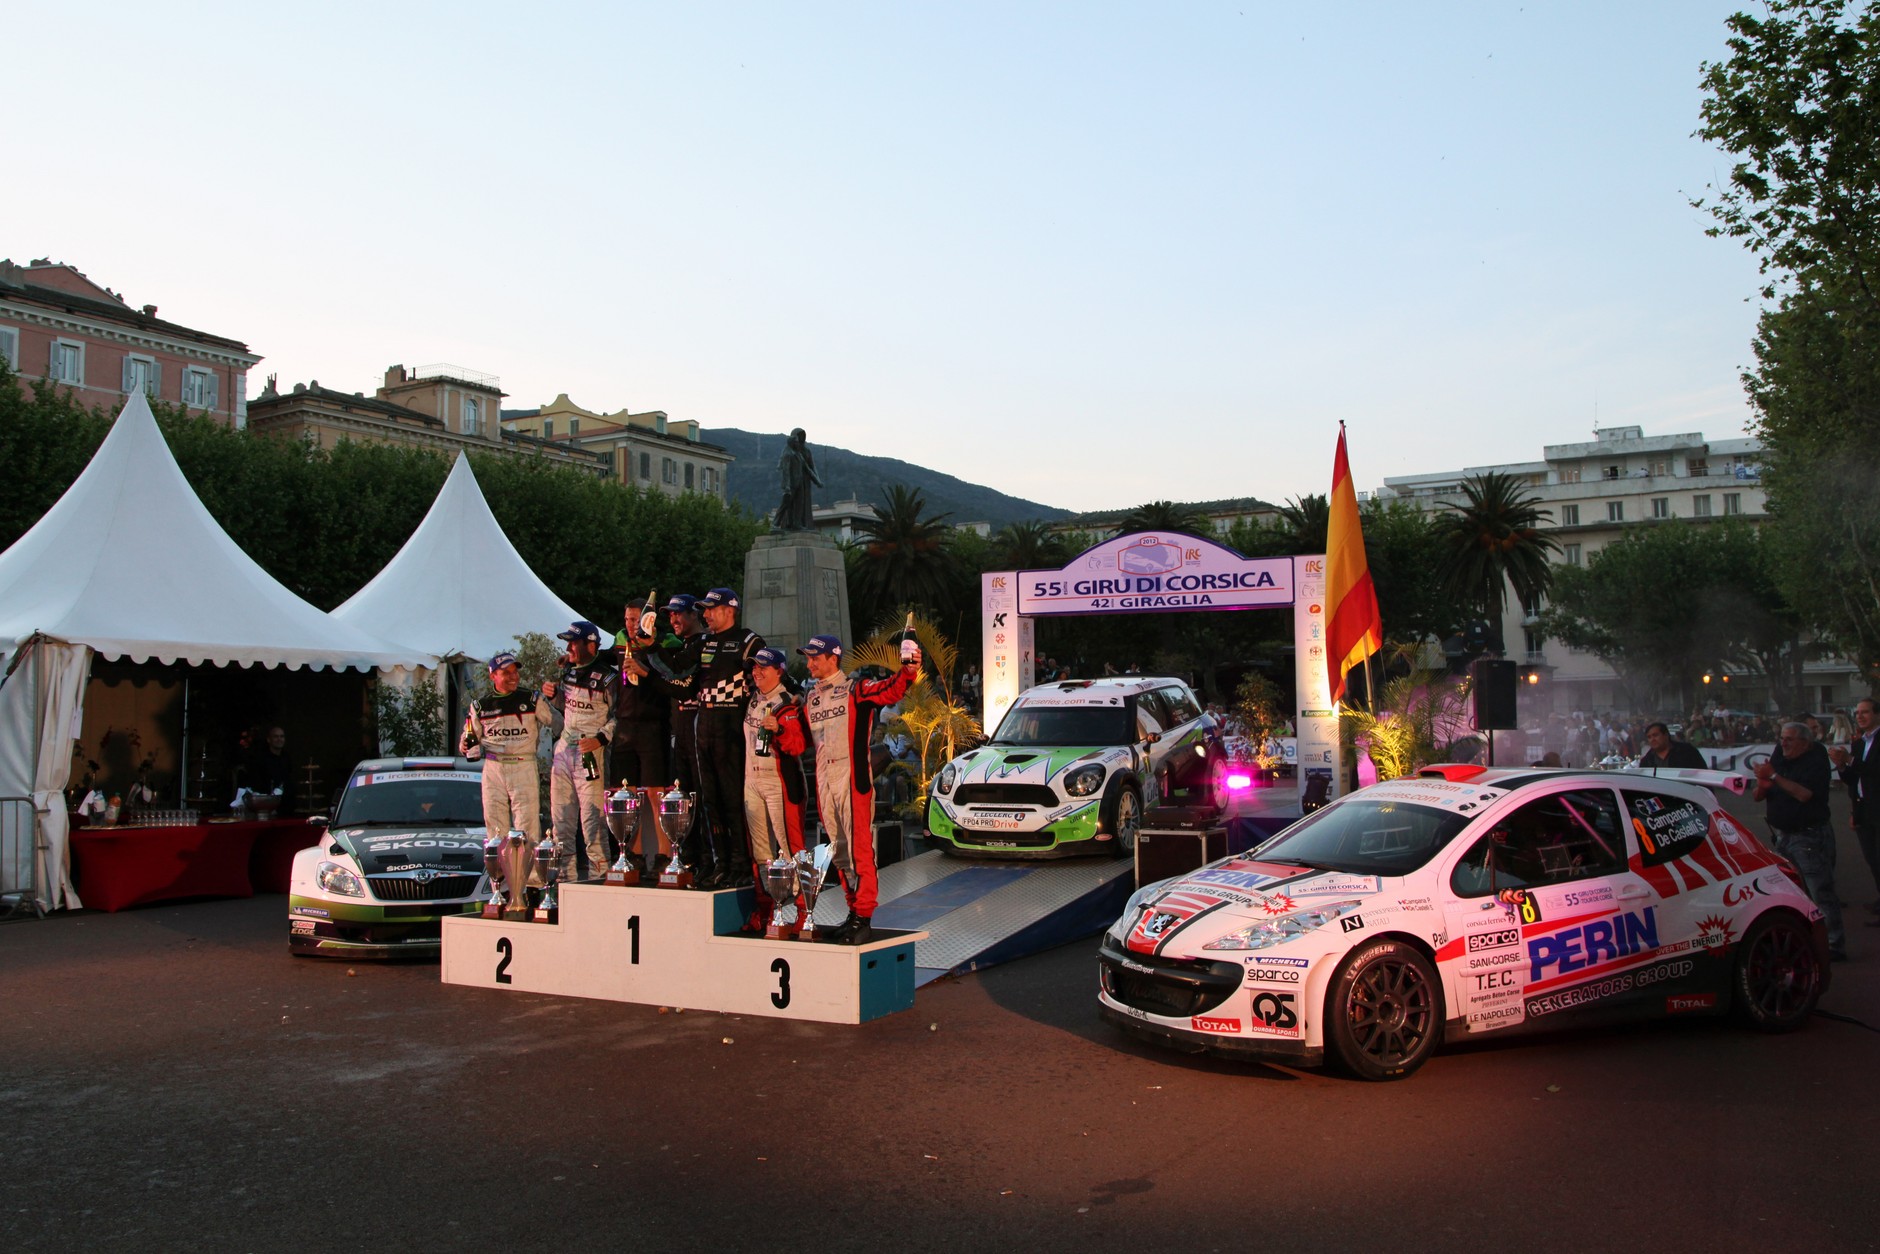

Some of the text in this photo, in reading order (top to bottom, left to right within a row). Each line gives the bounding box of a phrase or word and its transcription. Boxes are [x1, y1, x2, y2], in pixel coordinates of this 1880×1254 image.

[1034, 581, 1062, 597] 55
[1073, 579, 1131, 595] GIRU
[1136, 577, 1161, 593] DI
[1166, 571, 1275, 591] CORSICA
[1091, 598, 1110, 608] 42
[1119, 595, 1213, 608] GIRAGLIA
[1026, 698, 1086, 706] ircseries.com
[810, 705, 846, 723] sparco
[388, 771, 470, 780] ircseries.com
[1069, 807, 1097, 824] ultimate
[1646, 803, 1698, 830] Campana P.
[993, 820, 1019, 829] Drive
[1655, 833, 1671, 847] De
[1668, 820, 1698, 842] Castelli
[1696, 819, 1708, 831] S.
[1632, 818, 1656, 855] 8
[369, 840, 483, 851] ŠKODA
[386, 862, 462, 873] ŠKODA Motorsport
[1217, 891, 1251, 904] GROUP
[1565, 893, 1580, 907] 55
[1594, 886, 1613, 895] CORSICA
[1598, 893, 1614, 901] CORSE
[302, 908, 328, 917] MICHELIN
[1343, 915, 1362, 931] N
[1466, 916, 1507, 928] corsica ferries
[291, 928, 315, 936] EDGE
[627, 915, 640, 965] 1
[1470, 930, 1518, 950] sparco
[1528, 906, 1660, 982] PERIN
[1655, 933, 1723, 956] OVER THE ENERGY!
[495, 936, 513, 984] 2
[1259, 957, 1307, 967] MICHELIN
[1353, 944, 1396, 968] MICHELIN
[1469, 952, 1521, 969] SANI-CORSE
[770, 957, 791, 1009] 3
[1247, 968, 1300, 983] sparco
[1475, 969, 1517, 990] T.E.C.
[1527, 961, 1694, 1017] GENERATORS GROUP
[1252, 992, 1298, 1029] QS
[1670, 999, 1711, 1010] TOTAL
[1469, 1006, 1522, 1023] LE NAPOLEON
[1194, 1018, 1239, 1033] TOTAL
[1277, 1029, 1299, 1038] SPORTS
